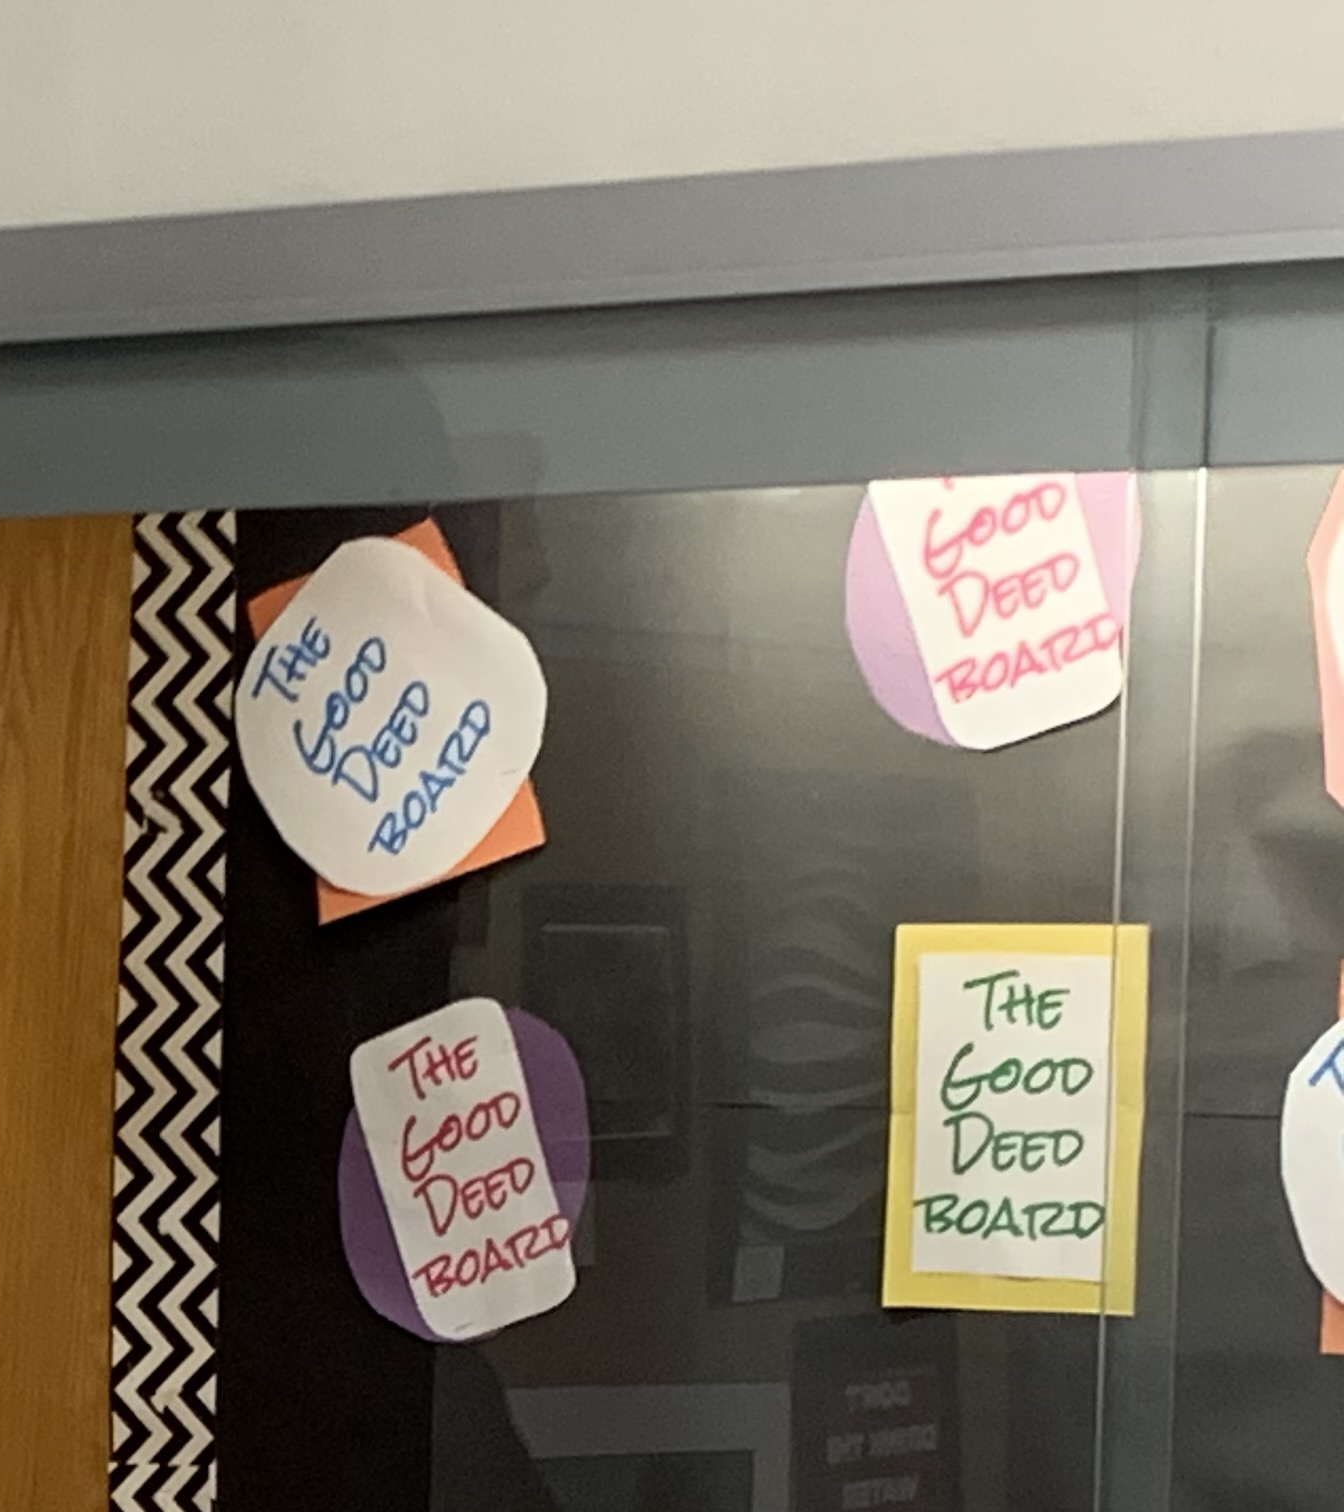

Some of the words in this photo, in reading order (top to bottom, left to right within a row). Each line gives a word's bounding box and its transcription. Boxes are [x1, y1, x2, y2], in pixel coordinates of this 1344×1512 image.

[924, 482, 1066, 580] GOOD
[938, 553, 1079, 638] DEED
[252, 616, 330, 702] THE
[934, 613, 1121, 703] BOARD
[294, 637, 386, 774] GOOD
[332, 680, 429, 802] DEED
[367, 700, 491, 855] BOARD
[963, 970, 1070, 1031] THE
[388, 1036, 479, 1099] THE
[941, 1042, 1094, 1111] GOOD
[401, 1092, 521, 1182] GOOD
[943, 1111, 1084, 1175] DEED
[413, 1157, 535, 1237] DEED
[914, 1194, 1105, 1240] BOARD
[411, 1214, 570, 1297] BOARD
